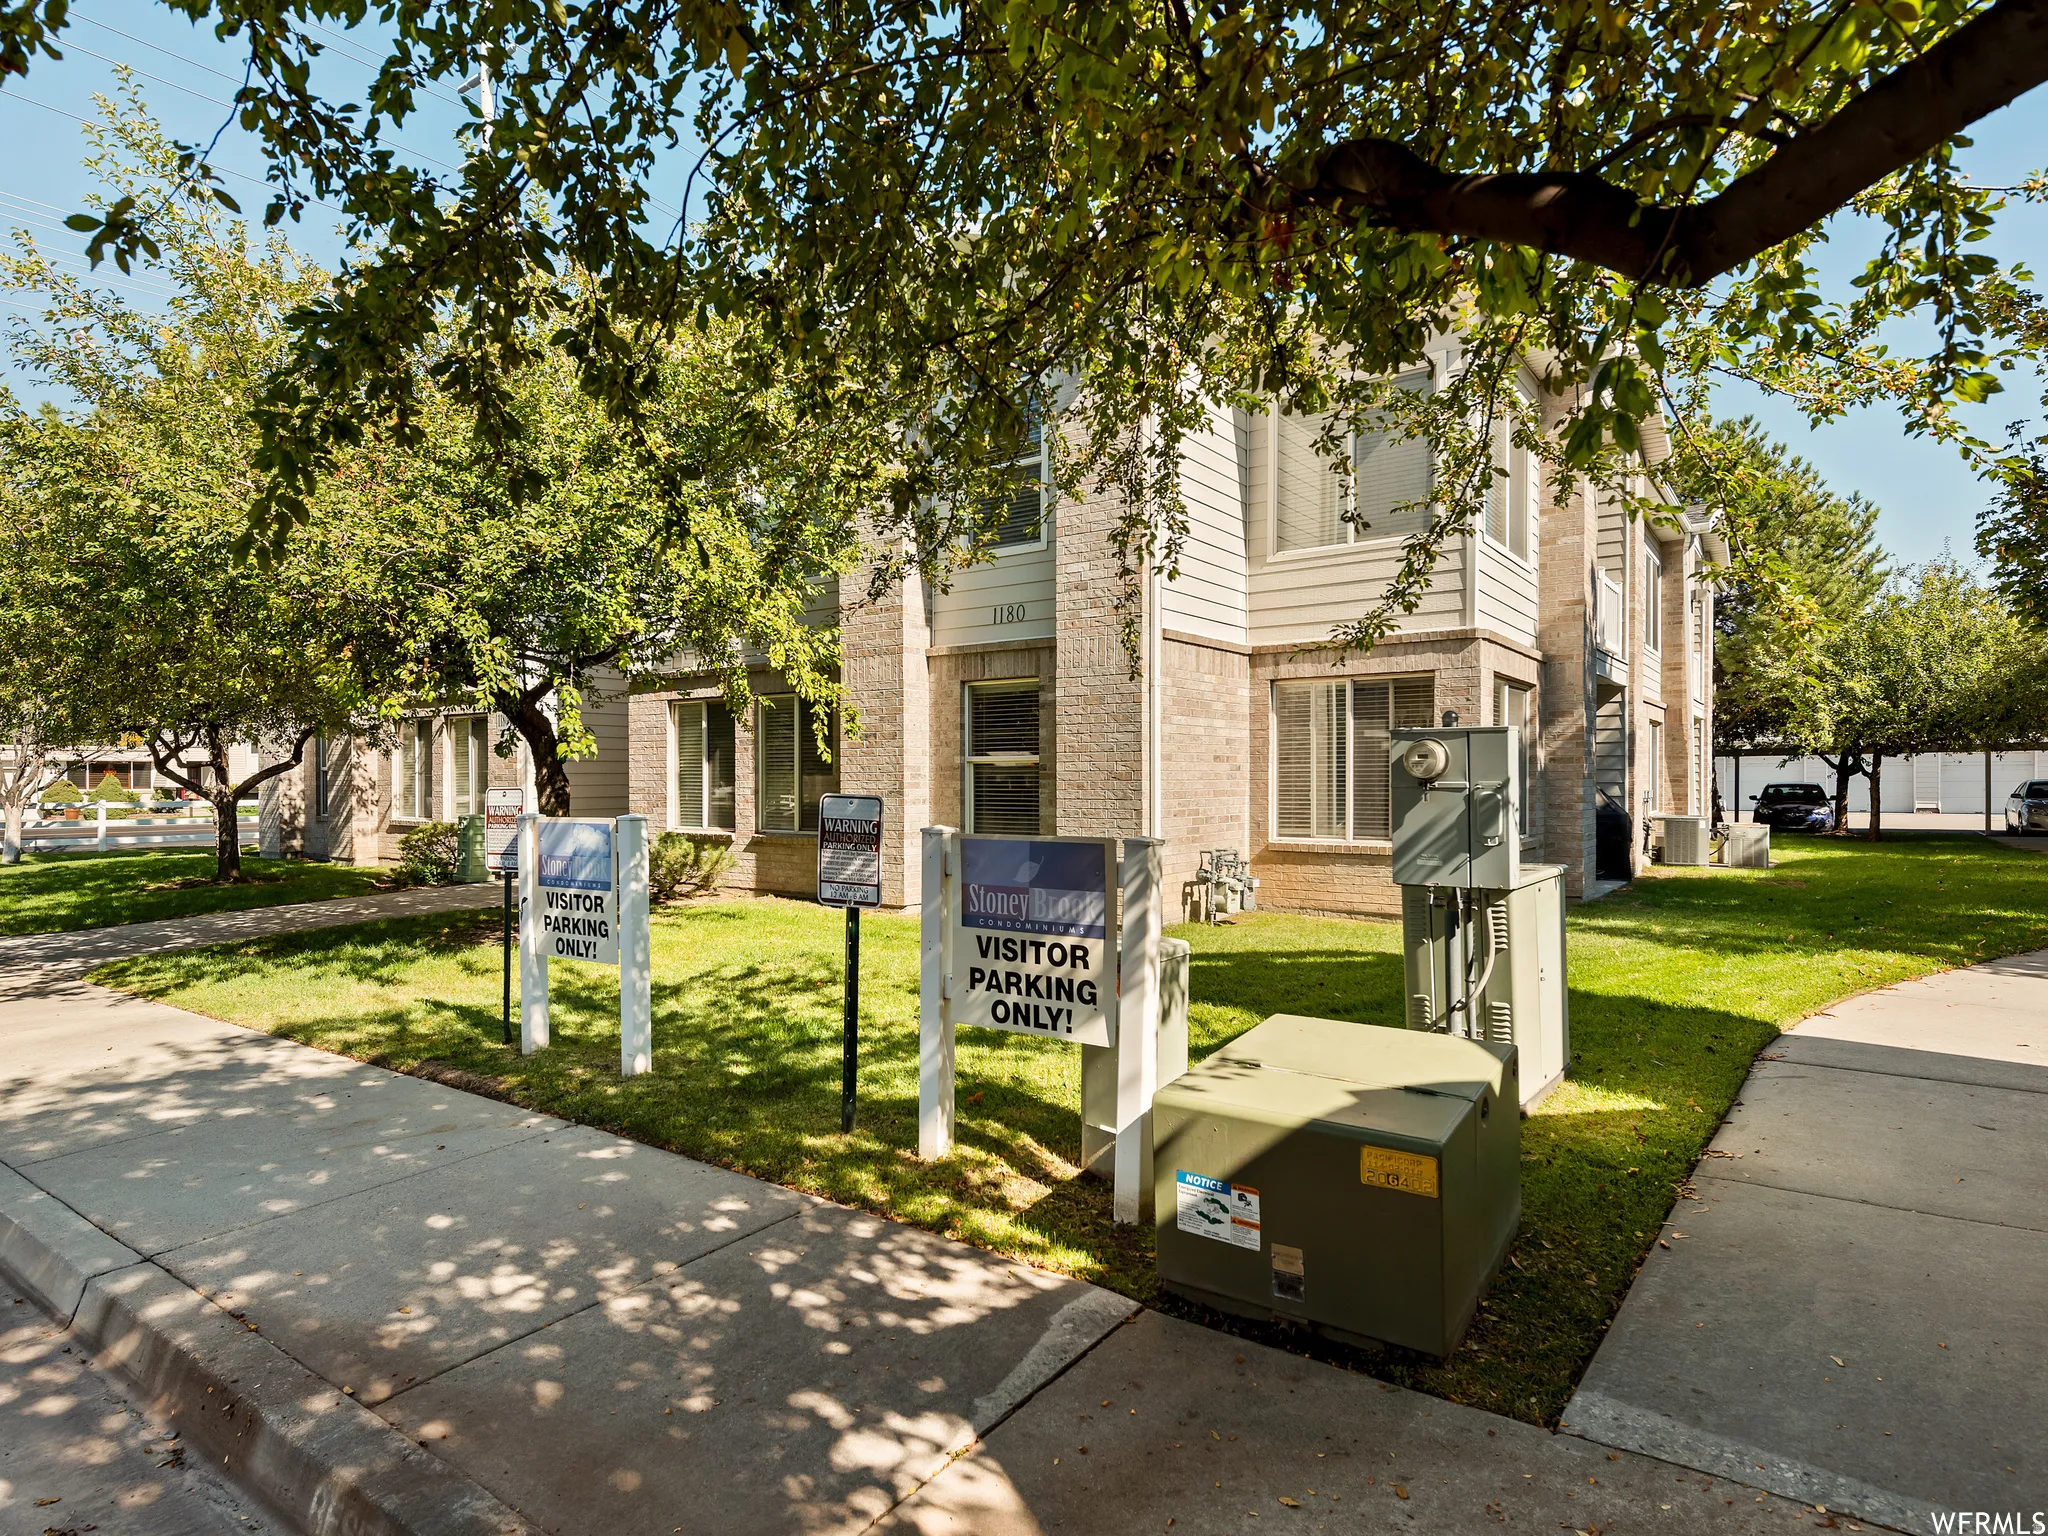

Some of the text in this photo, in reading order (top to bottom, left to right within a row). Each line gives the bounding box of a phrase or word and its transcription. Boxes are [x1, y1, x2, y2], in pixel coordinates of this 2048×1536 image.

[993, 604, 1025, 624] 1180
[488, 806, 522, 816] WARNING
[488, 816, 518, 824] AUTHORIZE
[824, 818, 878, 834] WARNING
[823, 841, 877, 852] PARKING ONLY
[824, 832, 876, 844] AUTHORIZED
[541, 855, 608, 880] Stoney Brook
[546, 880, 601, 888] CONDOMINIUMS
[830, 884, 869, 894] NO PARKING
[546, 891, 604, 914] VISITOR
[969, 883, 1097, 922] Stoney Brook
[544, 914, 609, 939] PARKING
[979, 918, 1084, 934] CONDOMINIUMS
[556, 936, 597, 959] ONLY!
[976, 934, 1090, 970] VISITOR
[969, 966, 1098, 1006] PARKING
[990, 999, 1073, 1034] ONLY!
[1366, 1151, 1422, 1167] PACIFICORP
[1185, 1174, 1223, 1191] NOTICE
